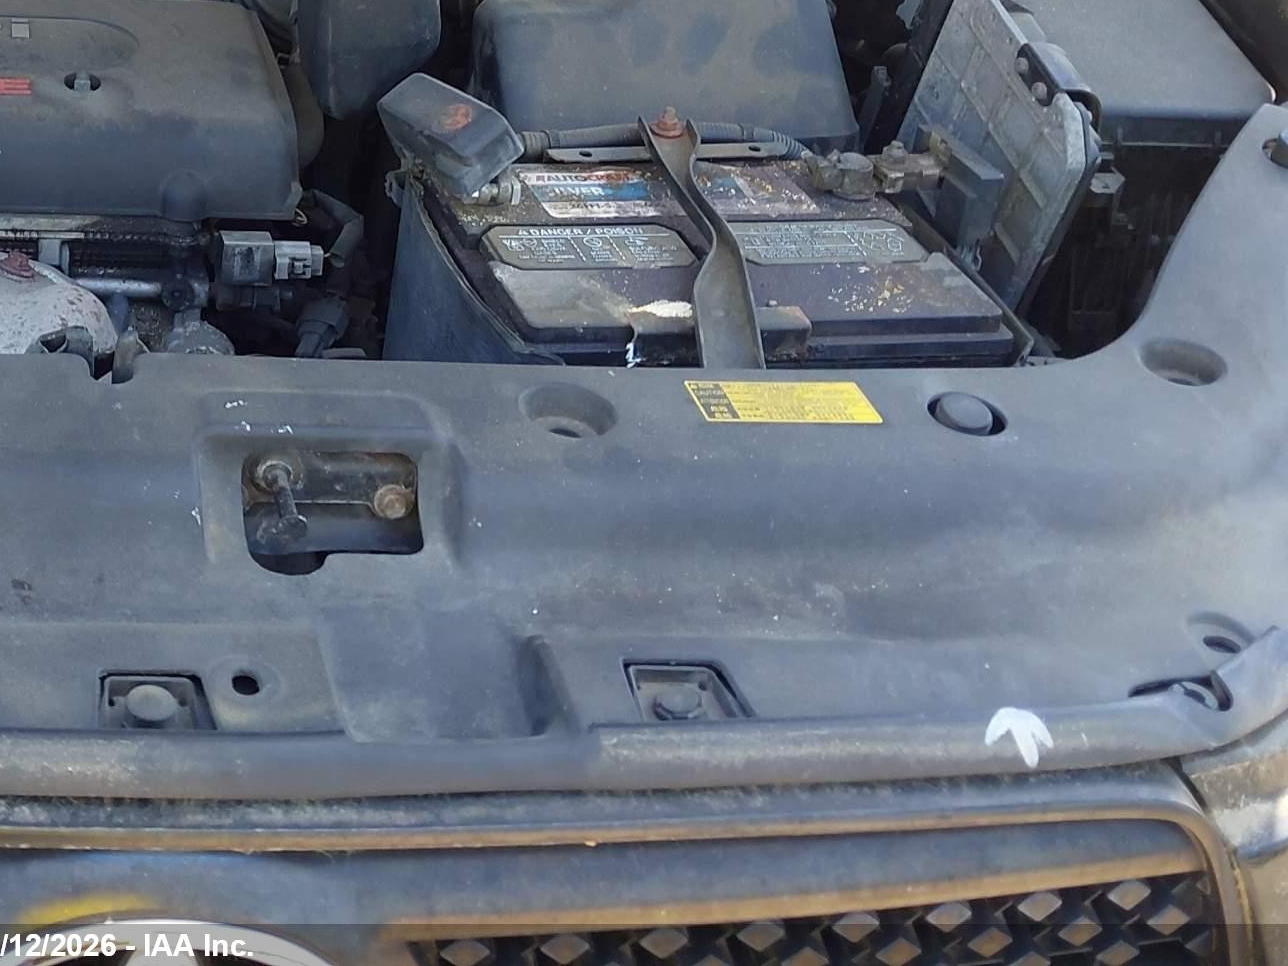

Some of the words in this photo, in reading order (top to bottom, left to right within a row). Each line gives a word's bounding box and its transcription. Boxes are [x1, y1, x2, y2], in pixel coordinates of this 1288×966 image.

[546, 172, 632, 183] AUTOCR
[529, 227, 583, 236] DANGER
[594, 227, 644, 235] POISON
